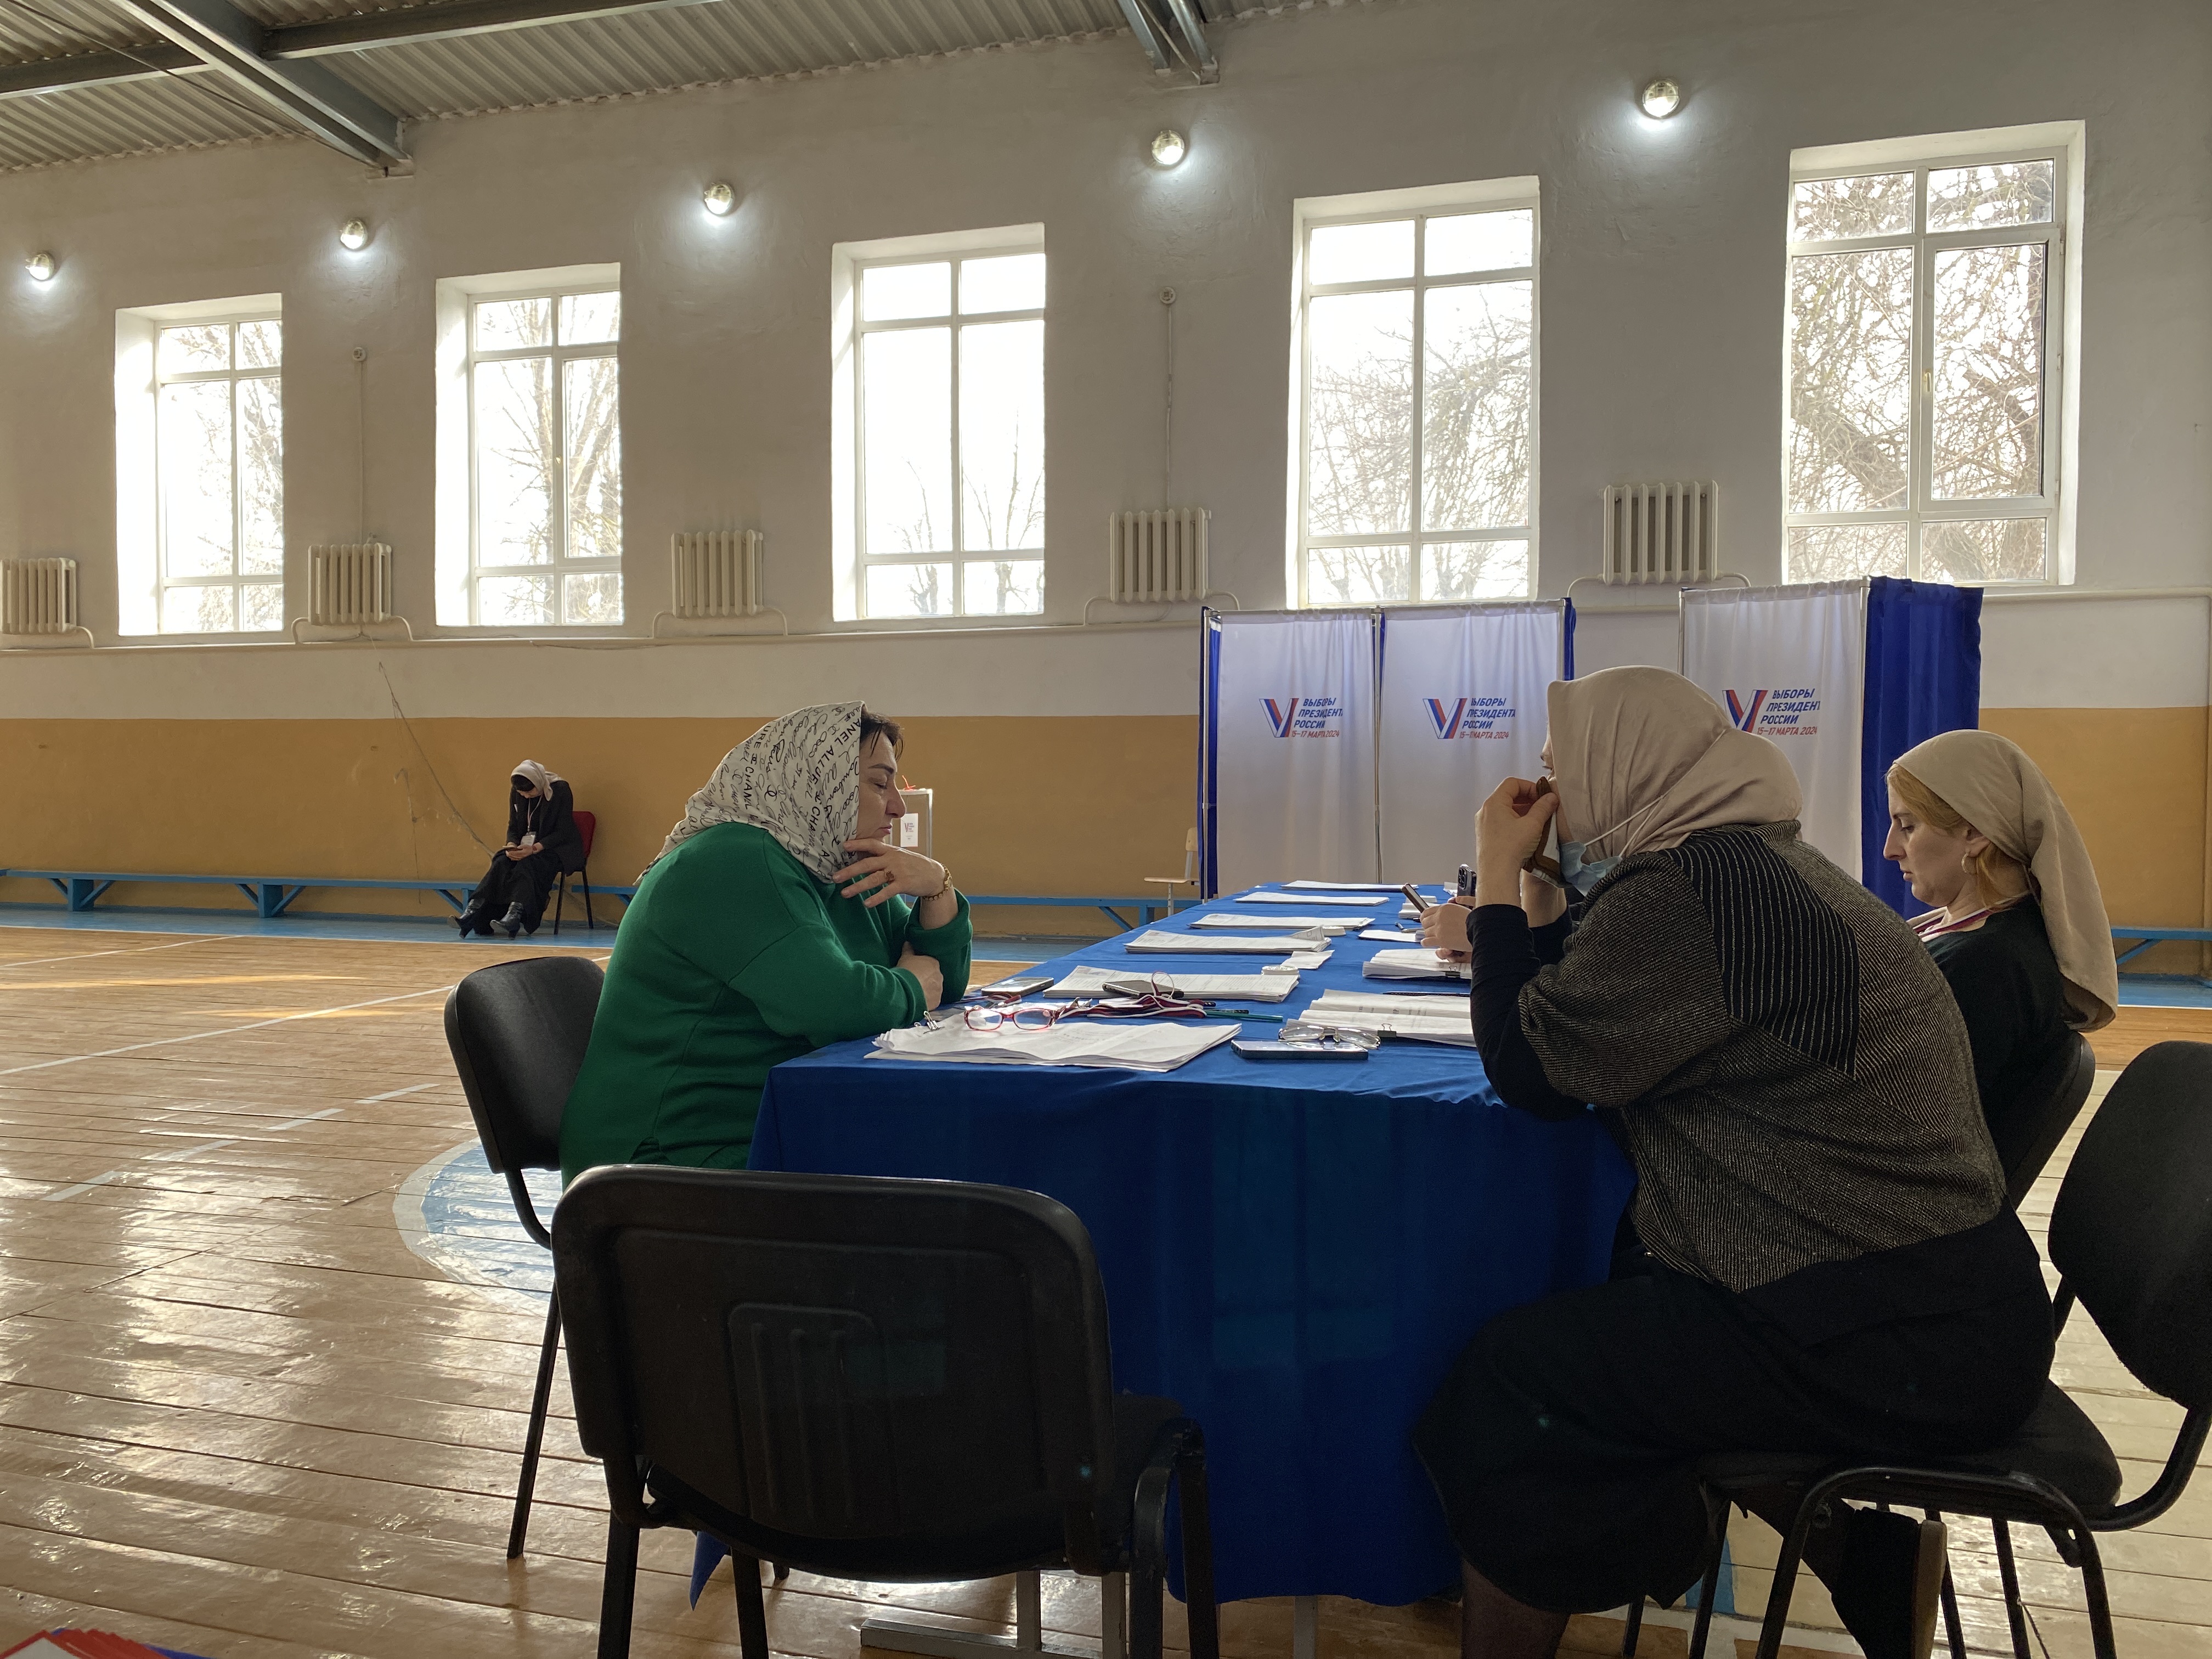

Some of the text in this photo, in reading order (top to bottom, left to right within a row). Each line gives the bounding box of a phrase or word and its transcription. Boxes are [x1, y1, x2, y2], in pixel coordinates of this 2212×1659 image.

[1773, 688, 1816, 699] ВЫБОРЫ
[1303, 697, 1336, 707] ВЫБОРЫ
[1298, 708, 1343, 719] ПРЕЗИДЕНТ
[1294, 720, 1325, 729] РОССИИ
[1462, 720, 1493, 729] РОССИИ
[1760, 715, 1799, 725] РОССИИ
[1325, 730, 1340, 738] 2024
[1776, 726, 1799, 735] МАРТА
[1799, 726, 1818, 735] 2024
